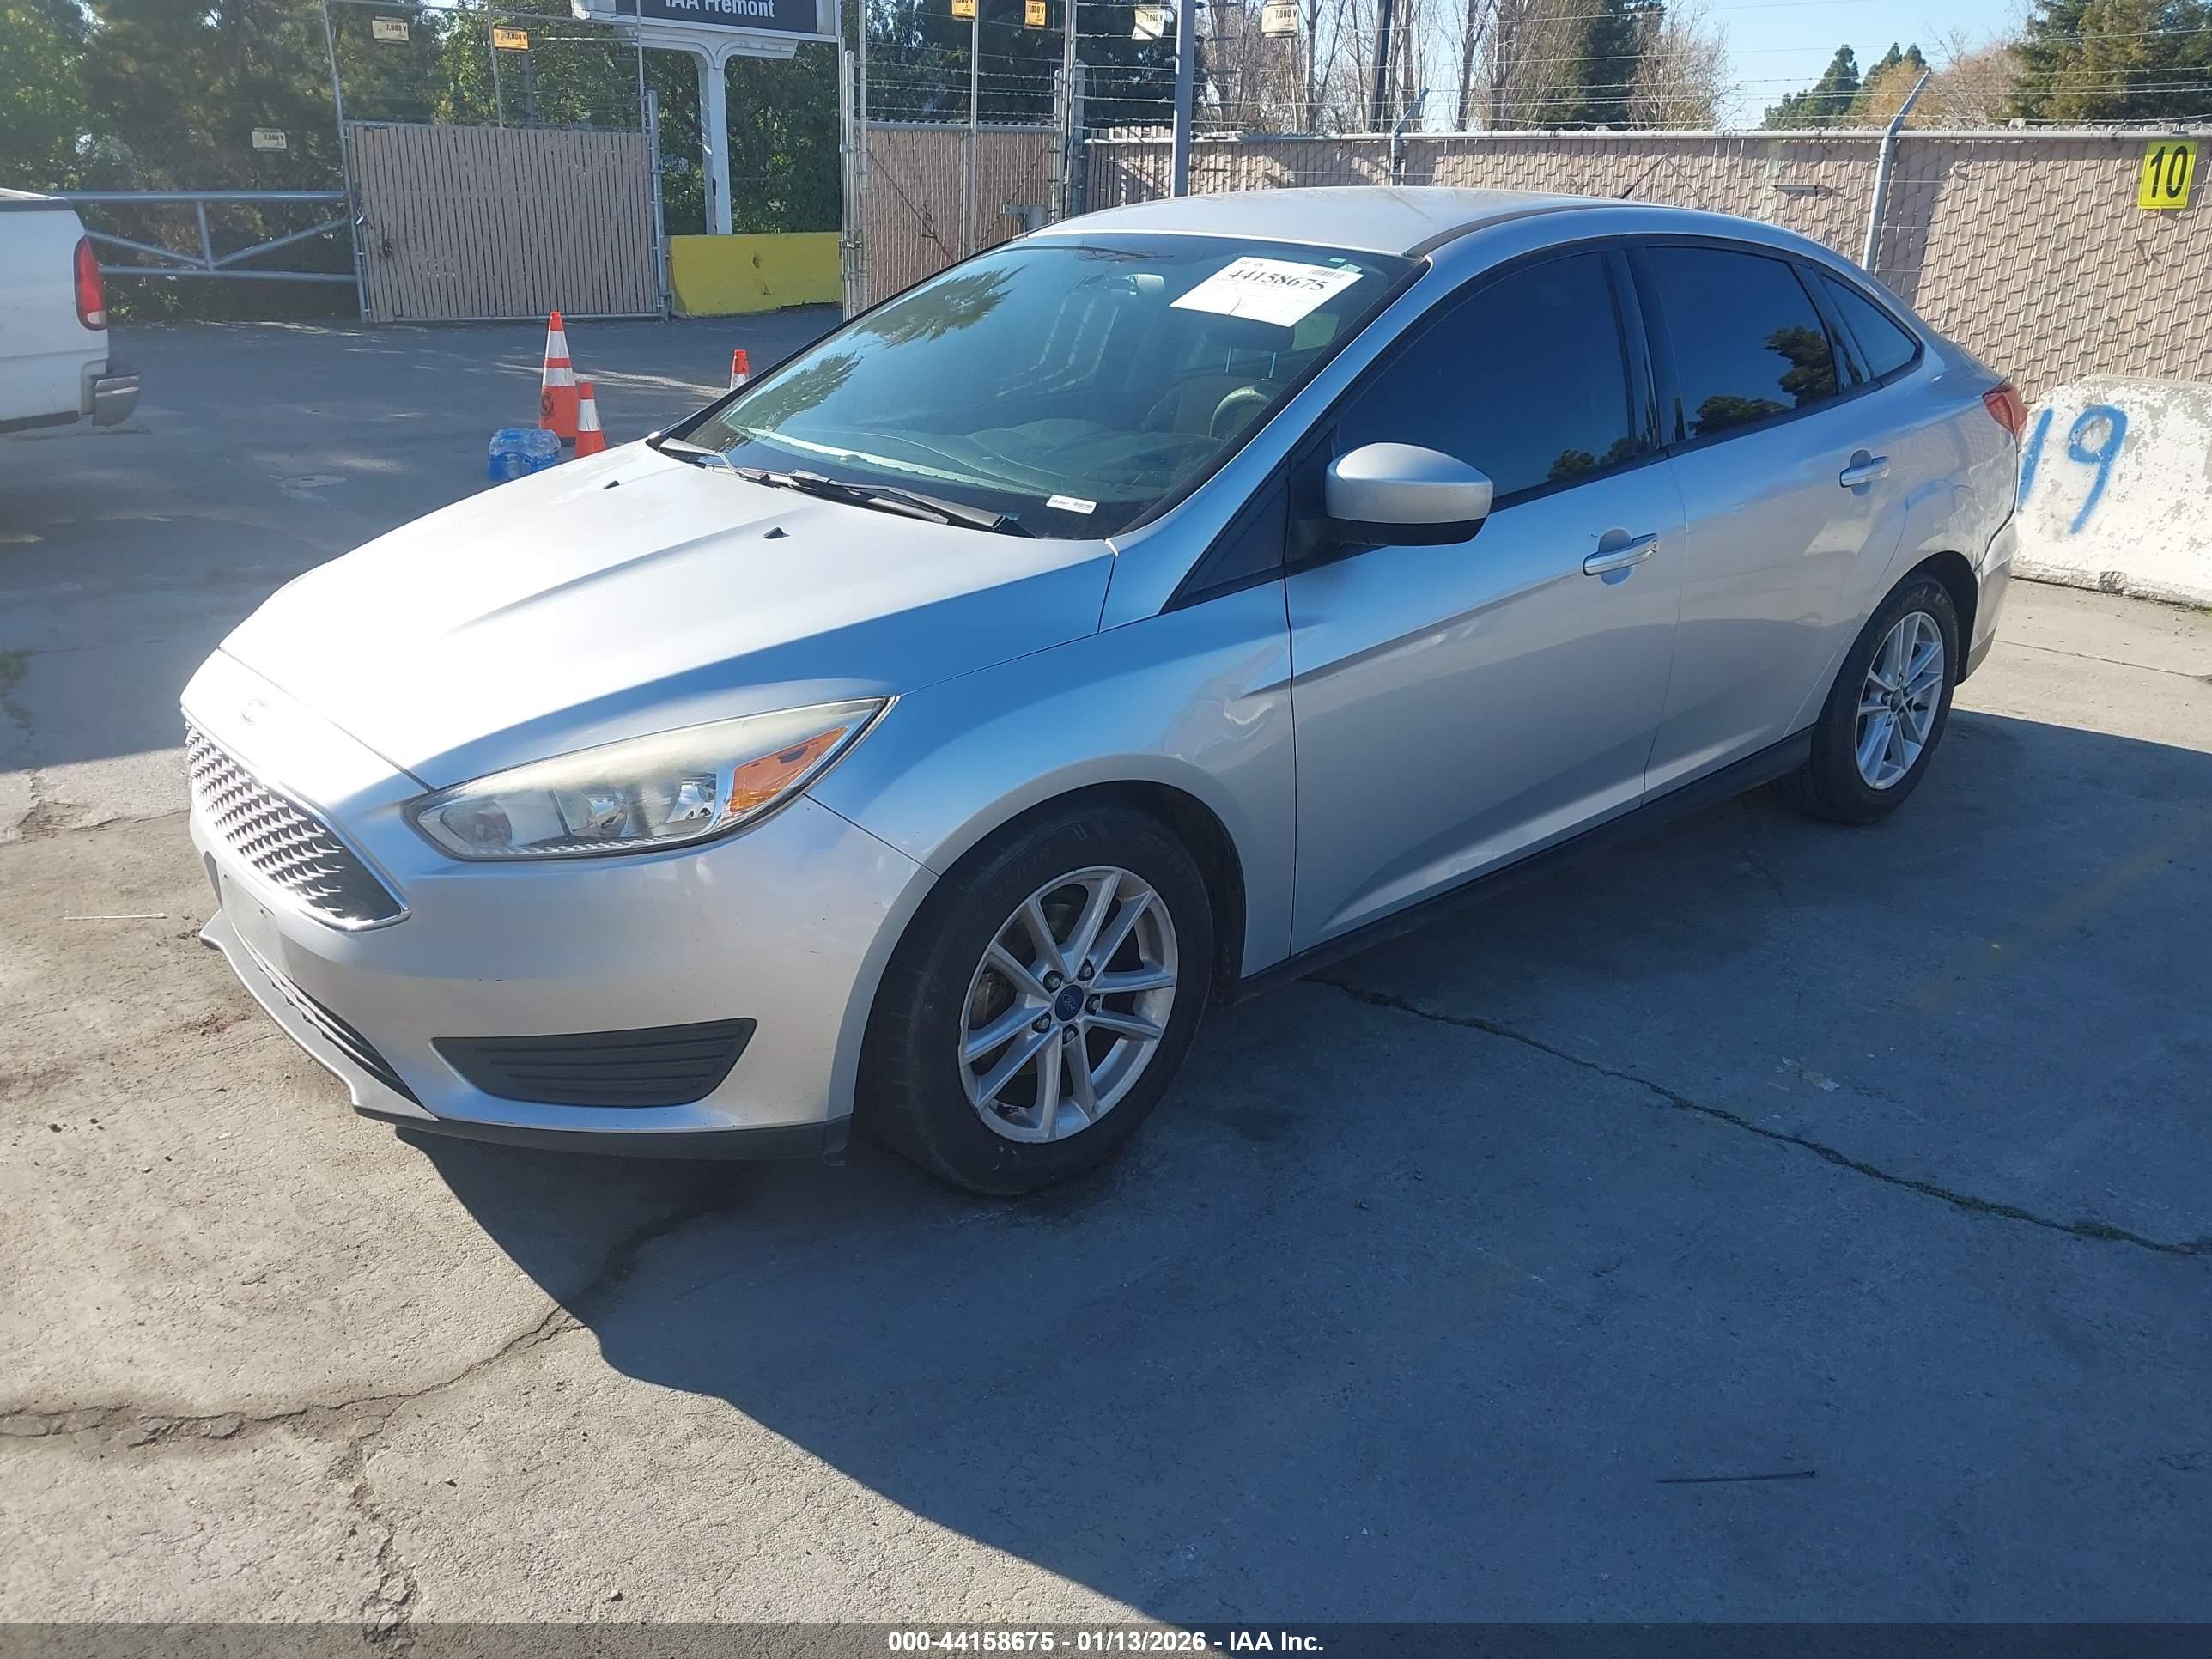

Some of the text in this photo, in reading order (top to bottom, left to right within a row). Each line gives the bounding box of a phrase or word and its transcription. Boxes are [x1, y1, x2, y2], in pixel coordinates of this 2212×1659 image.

[705, 0, 775, 17] Fremont
[1275, 9, 1297, 20] 7,000 V
[2149, 145, 2188, 198] 10
[1229, 270, 1332, 291] 44158675
[2017, 404, 2128, 534] 19
